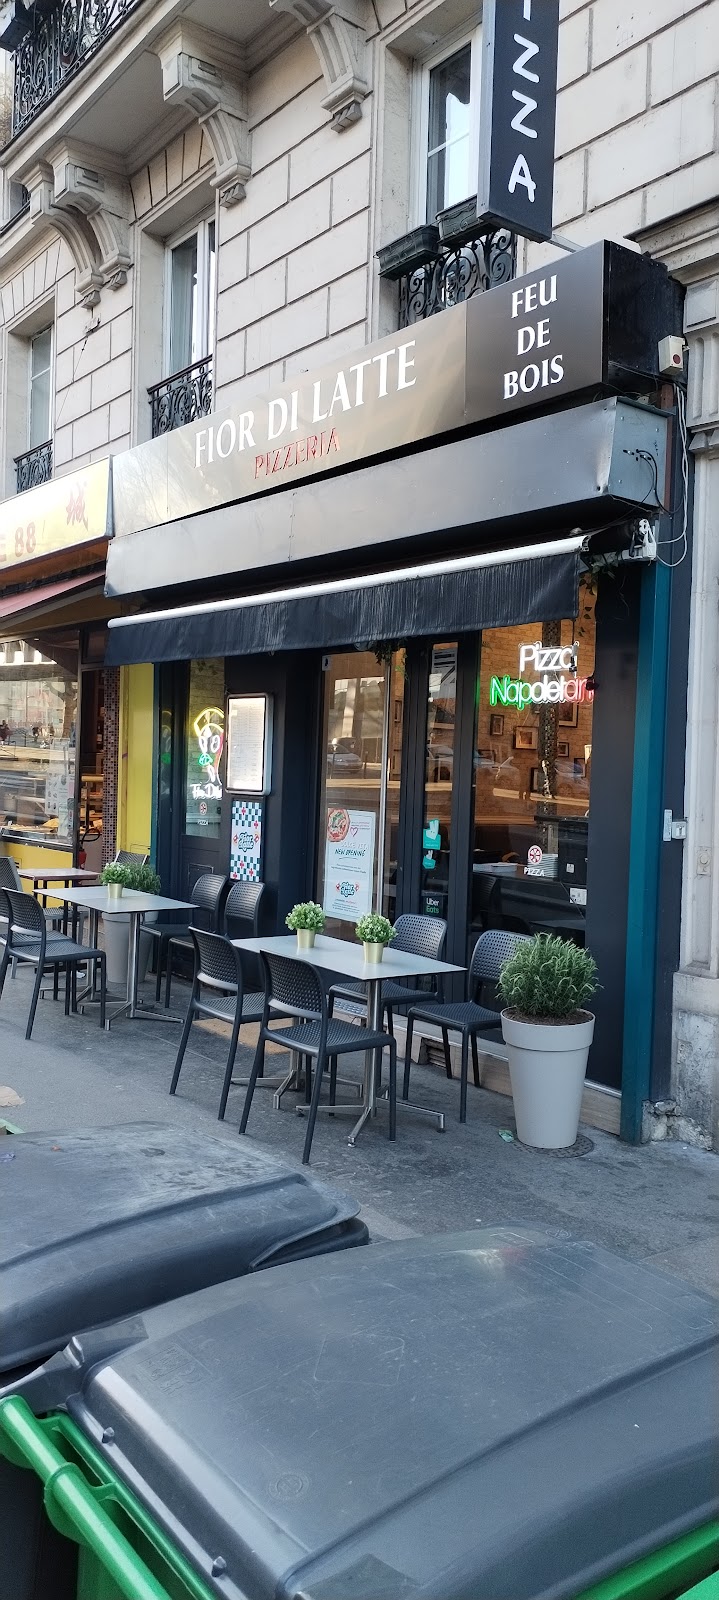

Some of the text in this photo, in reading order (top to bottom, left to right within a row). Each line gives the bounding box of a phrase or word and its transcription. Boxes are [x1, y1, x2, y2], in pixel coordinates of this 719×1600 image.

[511, 274, 558, 319] FEU
[516, 318, 551, 356] DE
[503, 354, 564, 400] BOIS
[193, 339, 417, 469] FIOR DI LATTE
[254, 427, 341, 480] PIZZERIA
[14, 521, 37, 558] 88
[345, 849, 366, 858] OPENING
[524, 866, 546, 877] PIZZA
[426, 897, 440, 907] Uber
[426, 905, 440, 914] Eats
